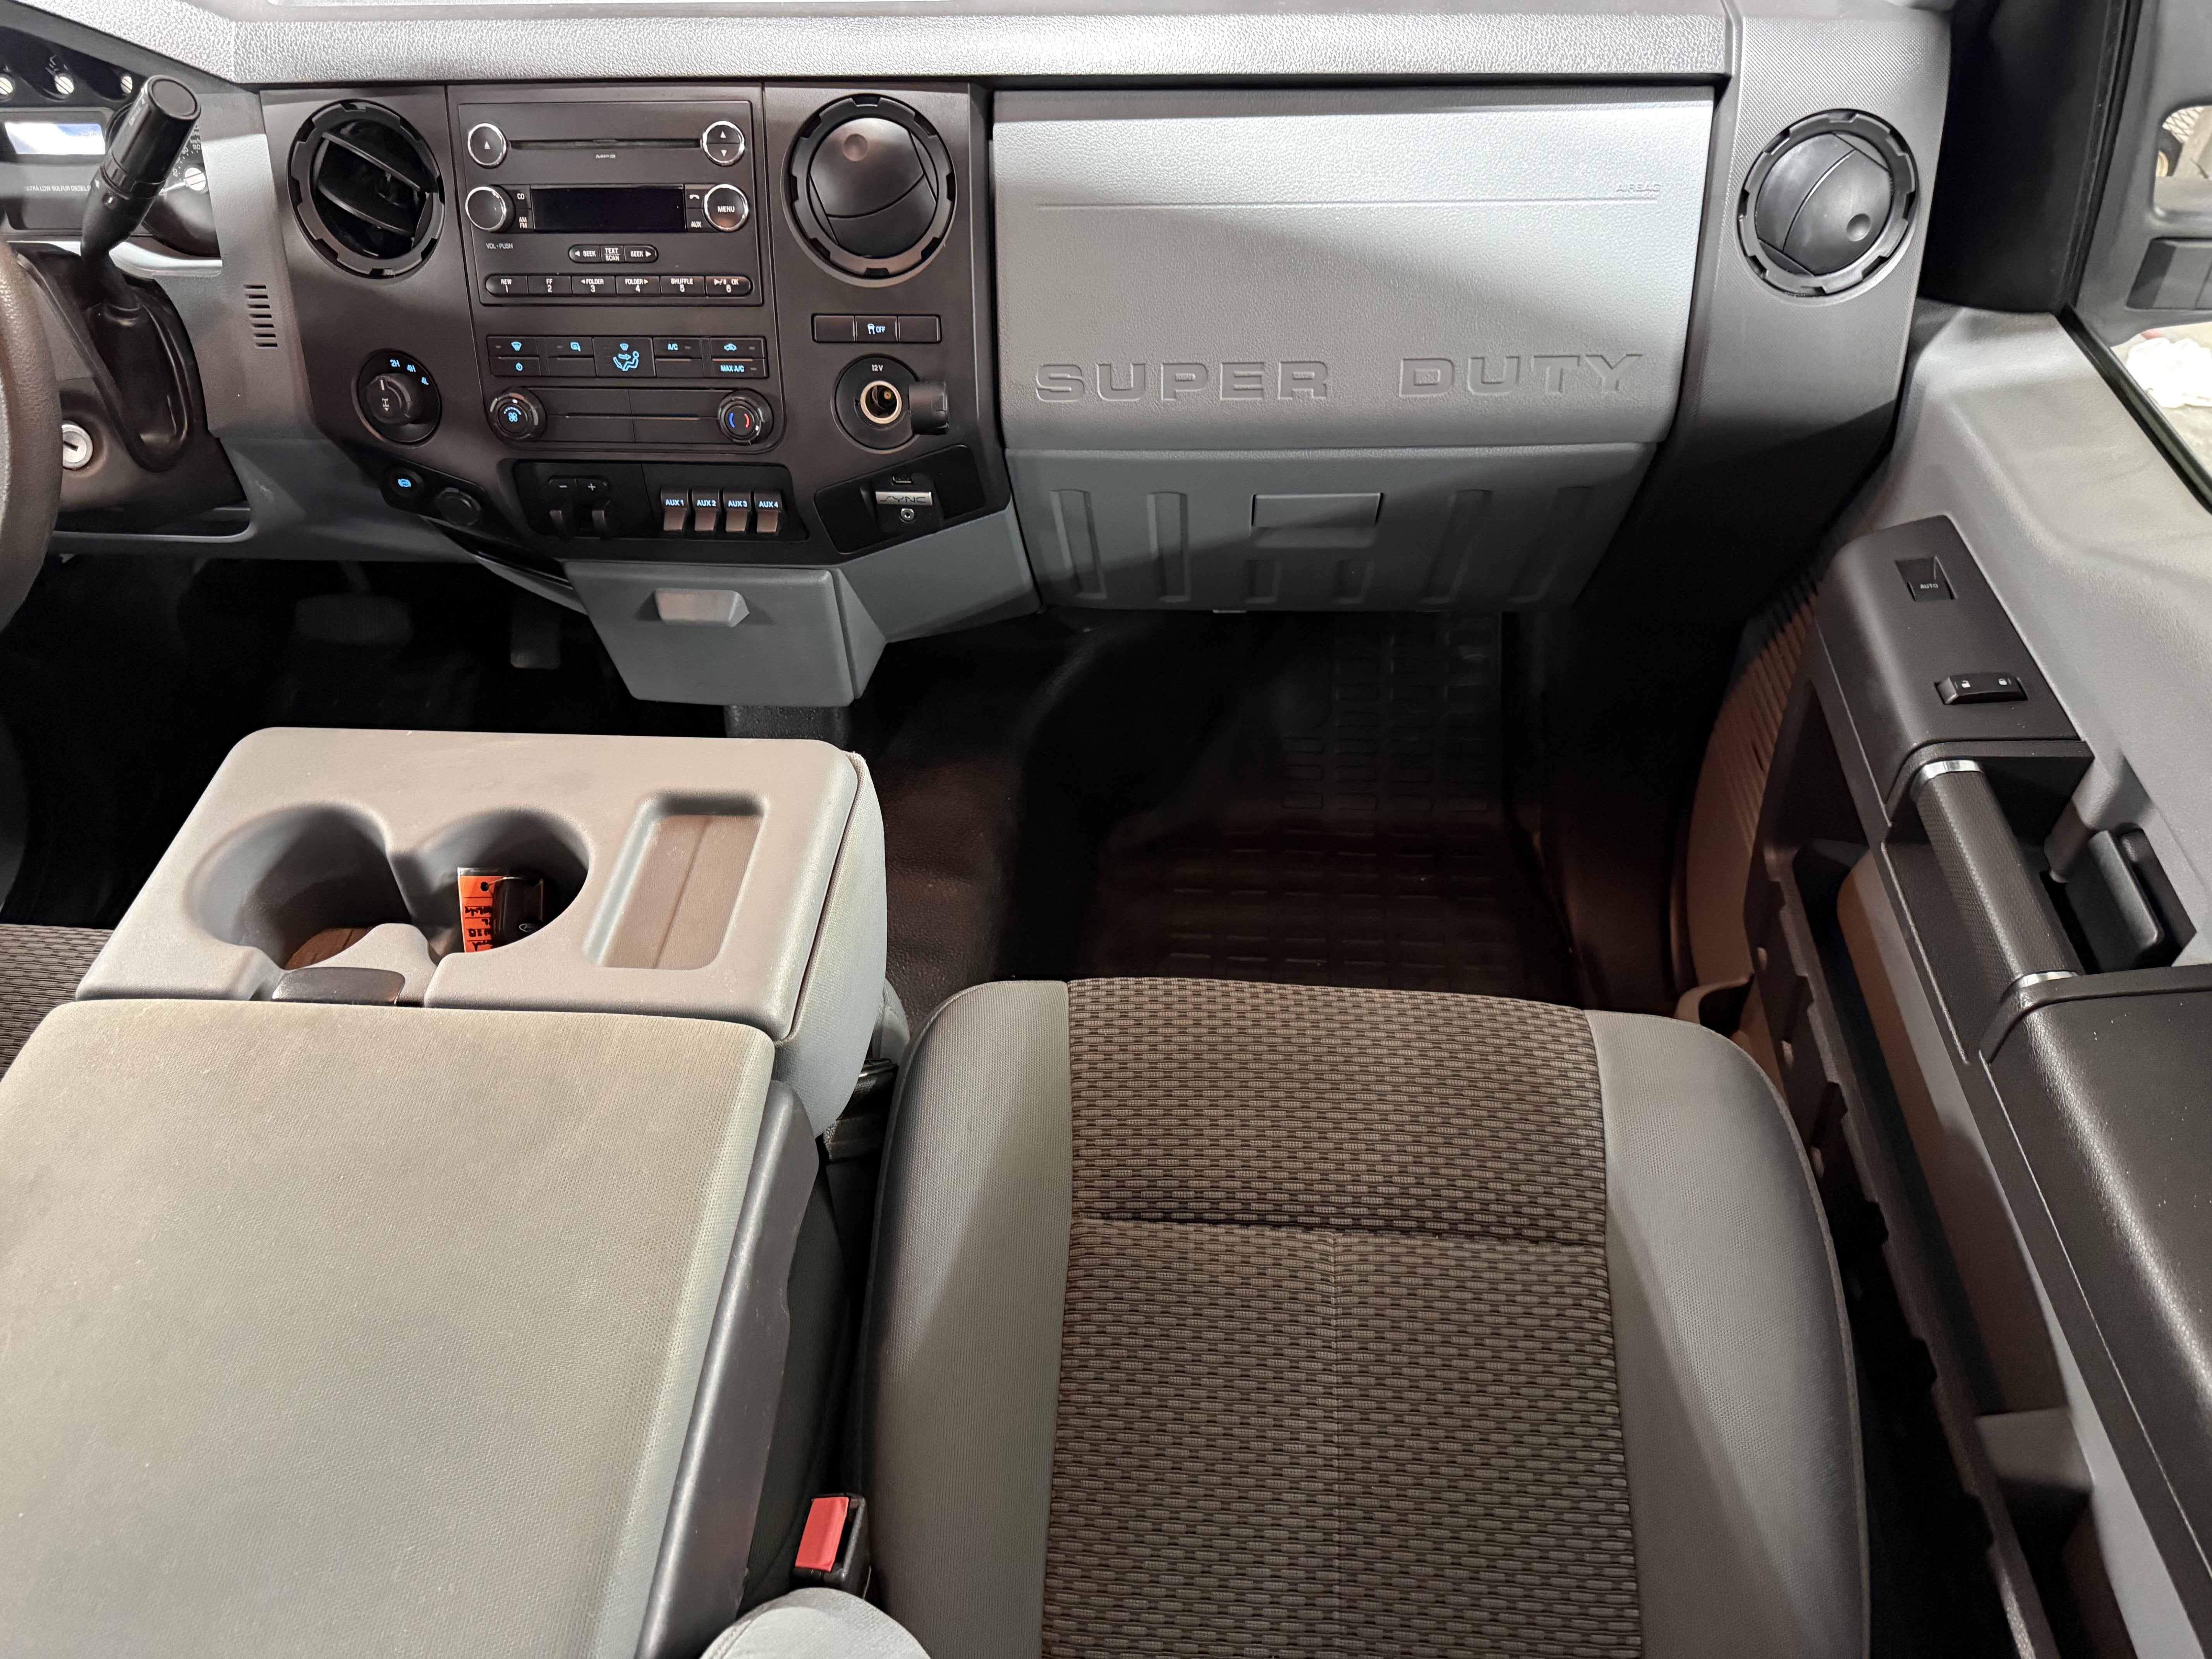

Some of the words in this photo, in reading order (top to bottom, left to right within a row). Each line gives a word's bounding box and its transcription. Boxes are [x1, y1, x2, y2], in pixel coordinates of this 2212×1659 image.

[1616, 184, 1661, 192] AIRBAG
[635, 285, 640, 293] 4
[680, 284, 685, 292] 5
[726, 284, 732, 293] 6
[390, 359, 400, 367] 2H
[407, 364, 416, 372] 4H
[421, 376, 429, 385] 4L
[1035, 361, 1328, 402] SUPER
[1399, 354, 1643, 397] DUTY
